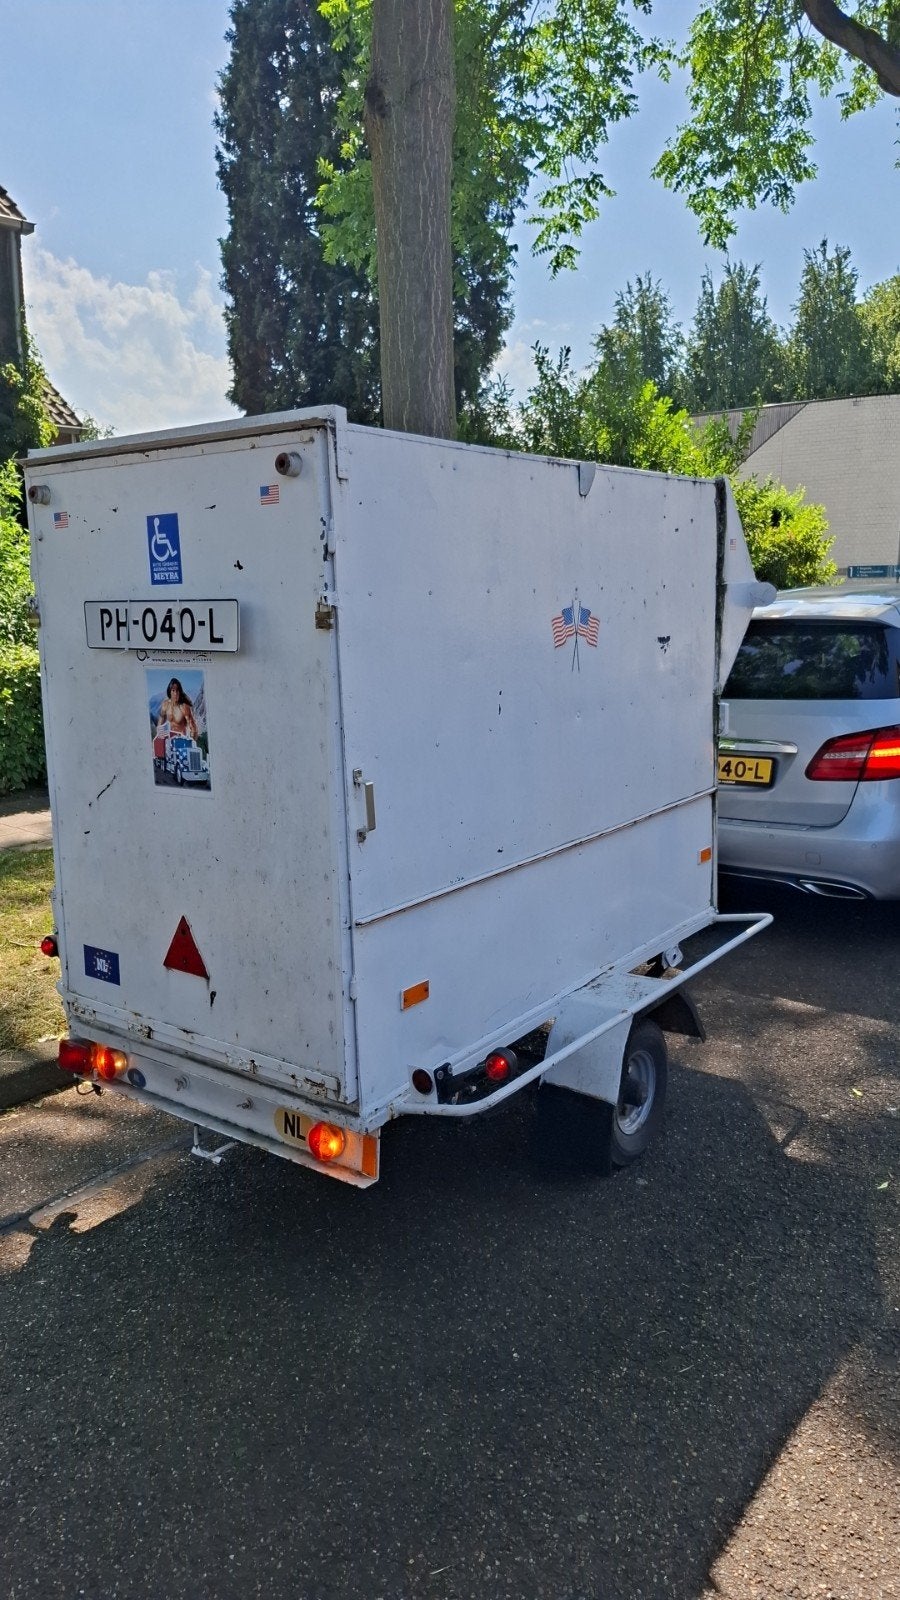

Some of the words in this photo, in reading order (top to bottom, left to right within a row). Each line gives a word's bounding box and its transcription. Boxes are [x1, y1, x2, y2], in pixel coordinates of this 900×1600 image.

[100, 607, 224, 643] PH-040-L
[718, 760, 764, 780] 40-L
[96, 957, 108, 973] NL
[284, 1111, 306, 1141] NL
